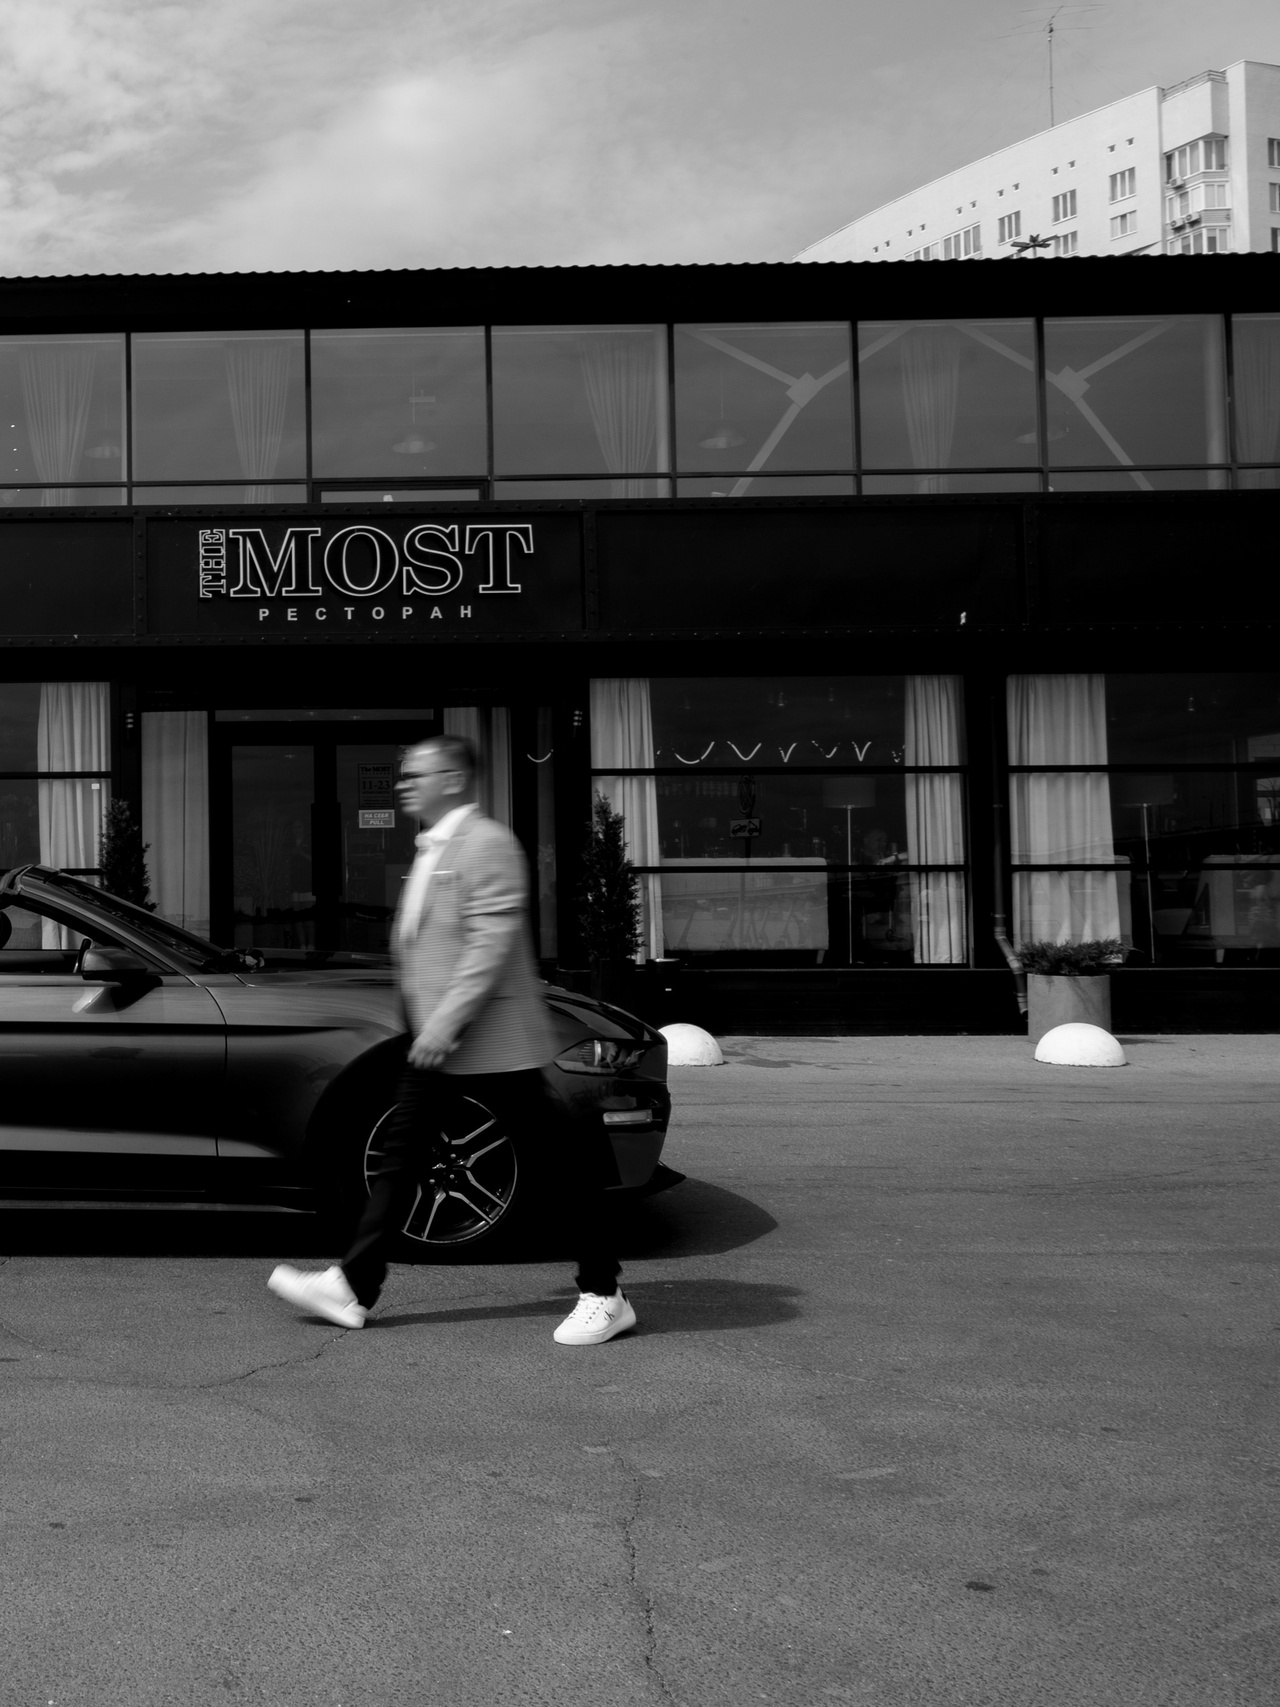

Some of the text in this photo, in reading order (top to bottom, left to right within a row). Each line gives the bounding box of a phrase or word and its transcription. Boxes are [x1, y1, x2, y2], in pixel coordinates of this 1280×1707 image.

[198, 523, 535, 599] THE MOST
[258, 604, 473, 622] РЕСТОРАН
[363, 780, 390, 790] 11-23
